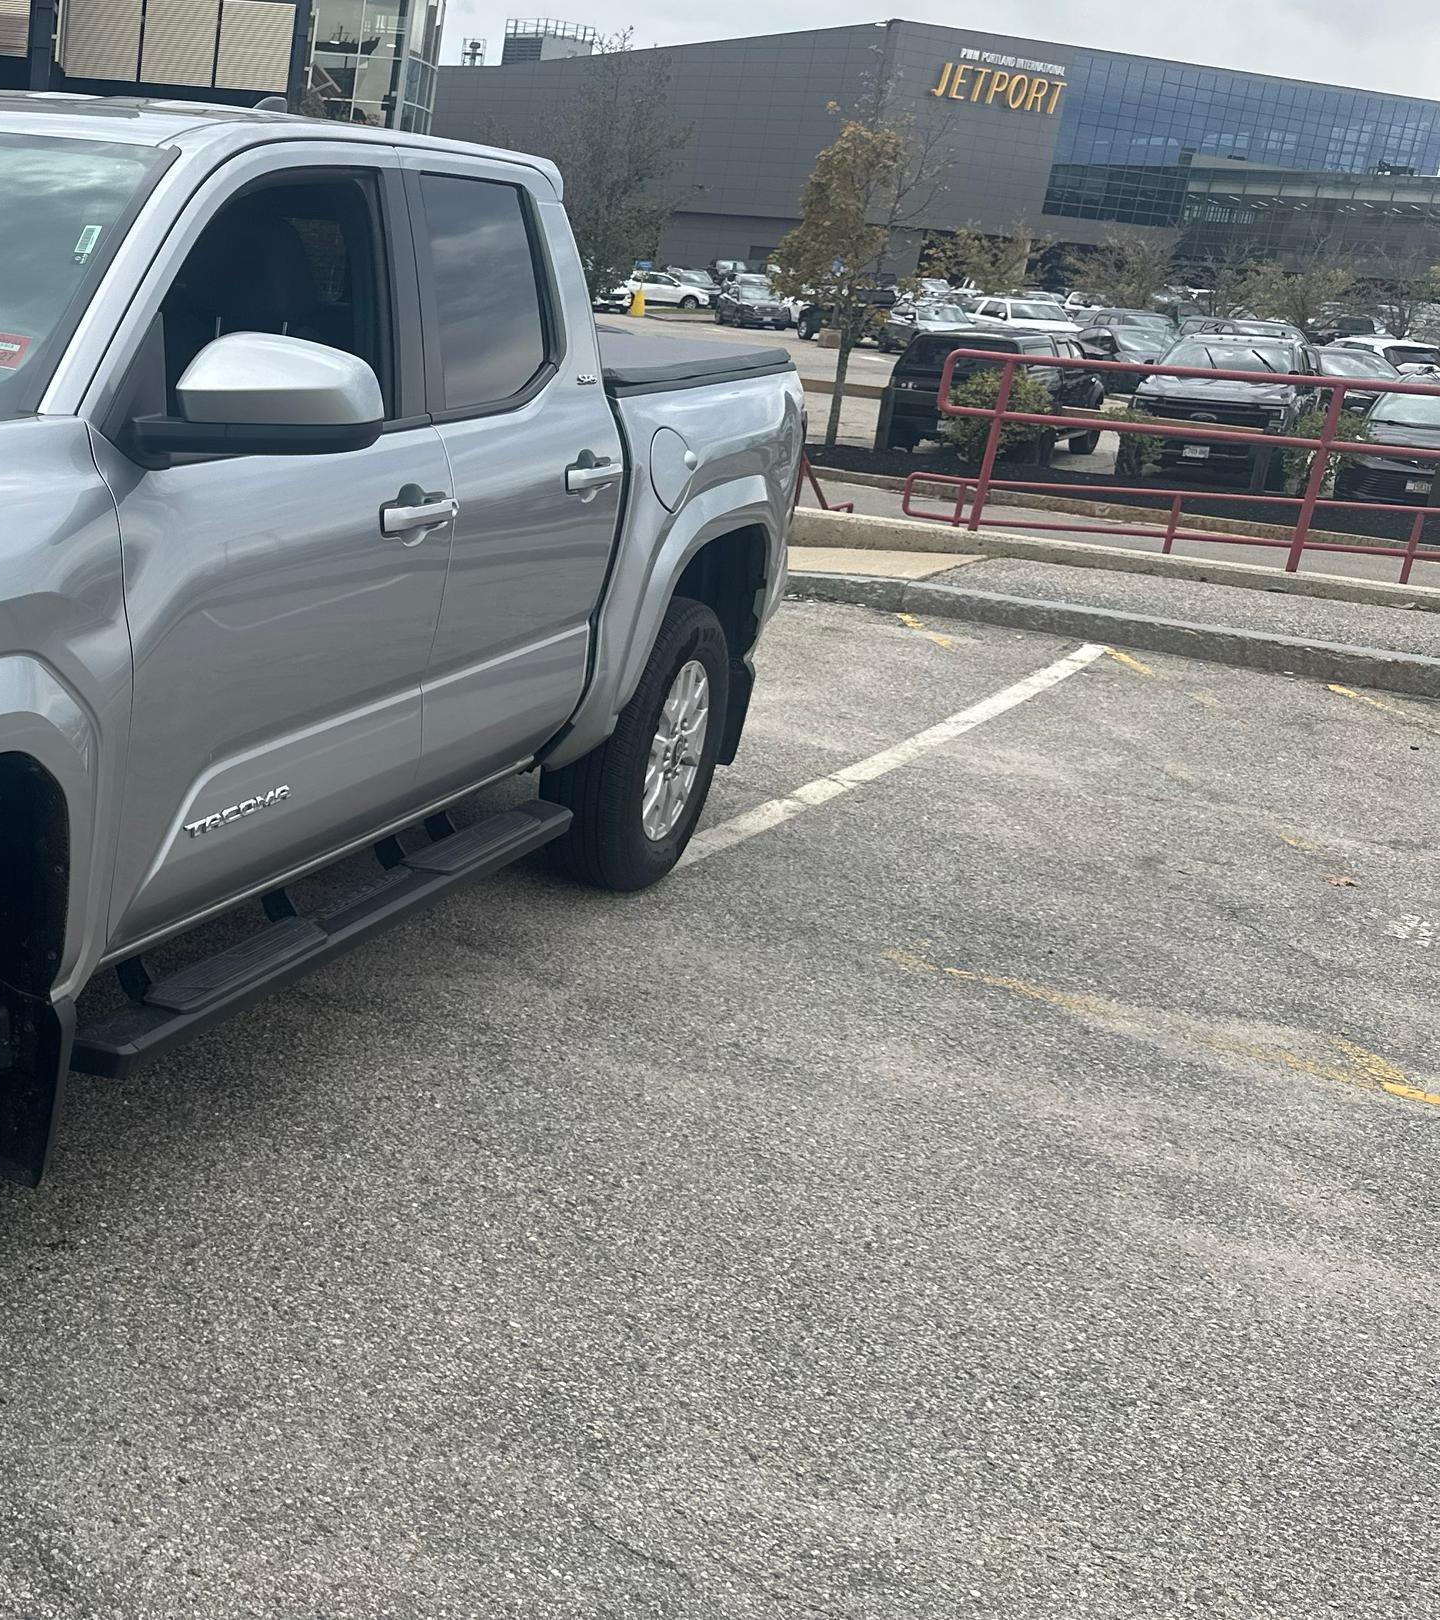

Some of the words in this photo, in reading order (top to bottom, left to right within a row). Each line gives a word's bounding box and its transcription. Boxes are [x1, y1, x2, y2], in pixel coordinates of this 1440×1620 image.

[930, 62, 1068, 114] JETPORT
[960, 48, 980, 61] PWM
[981, 51, 1016, 68] PORTLAND
[1015, 58, 1065, 77] INTERNATIONAL
[184, 784, 292, 838] TACOMA
